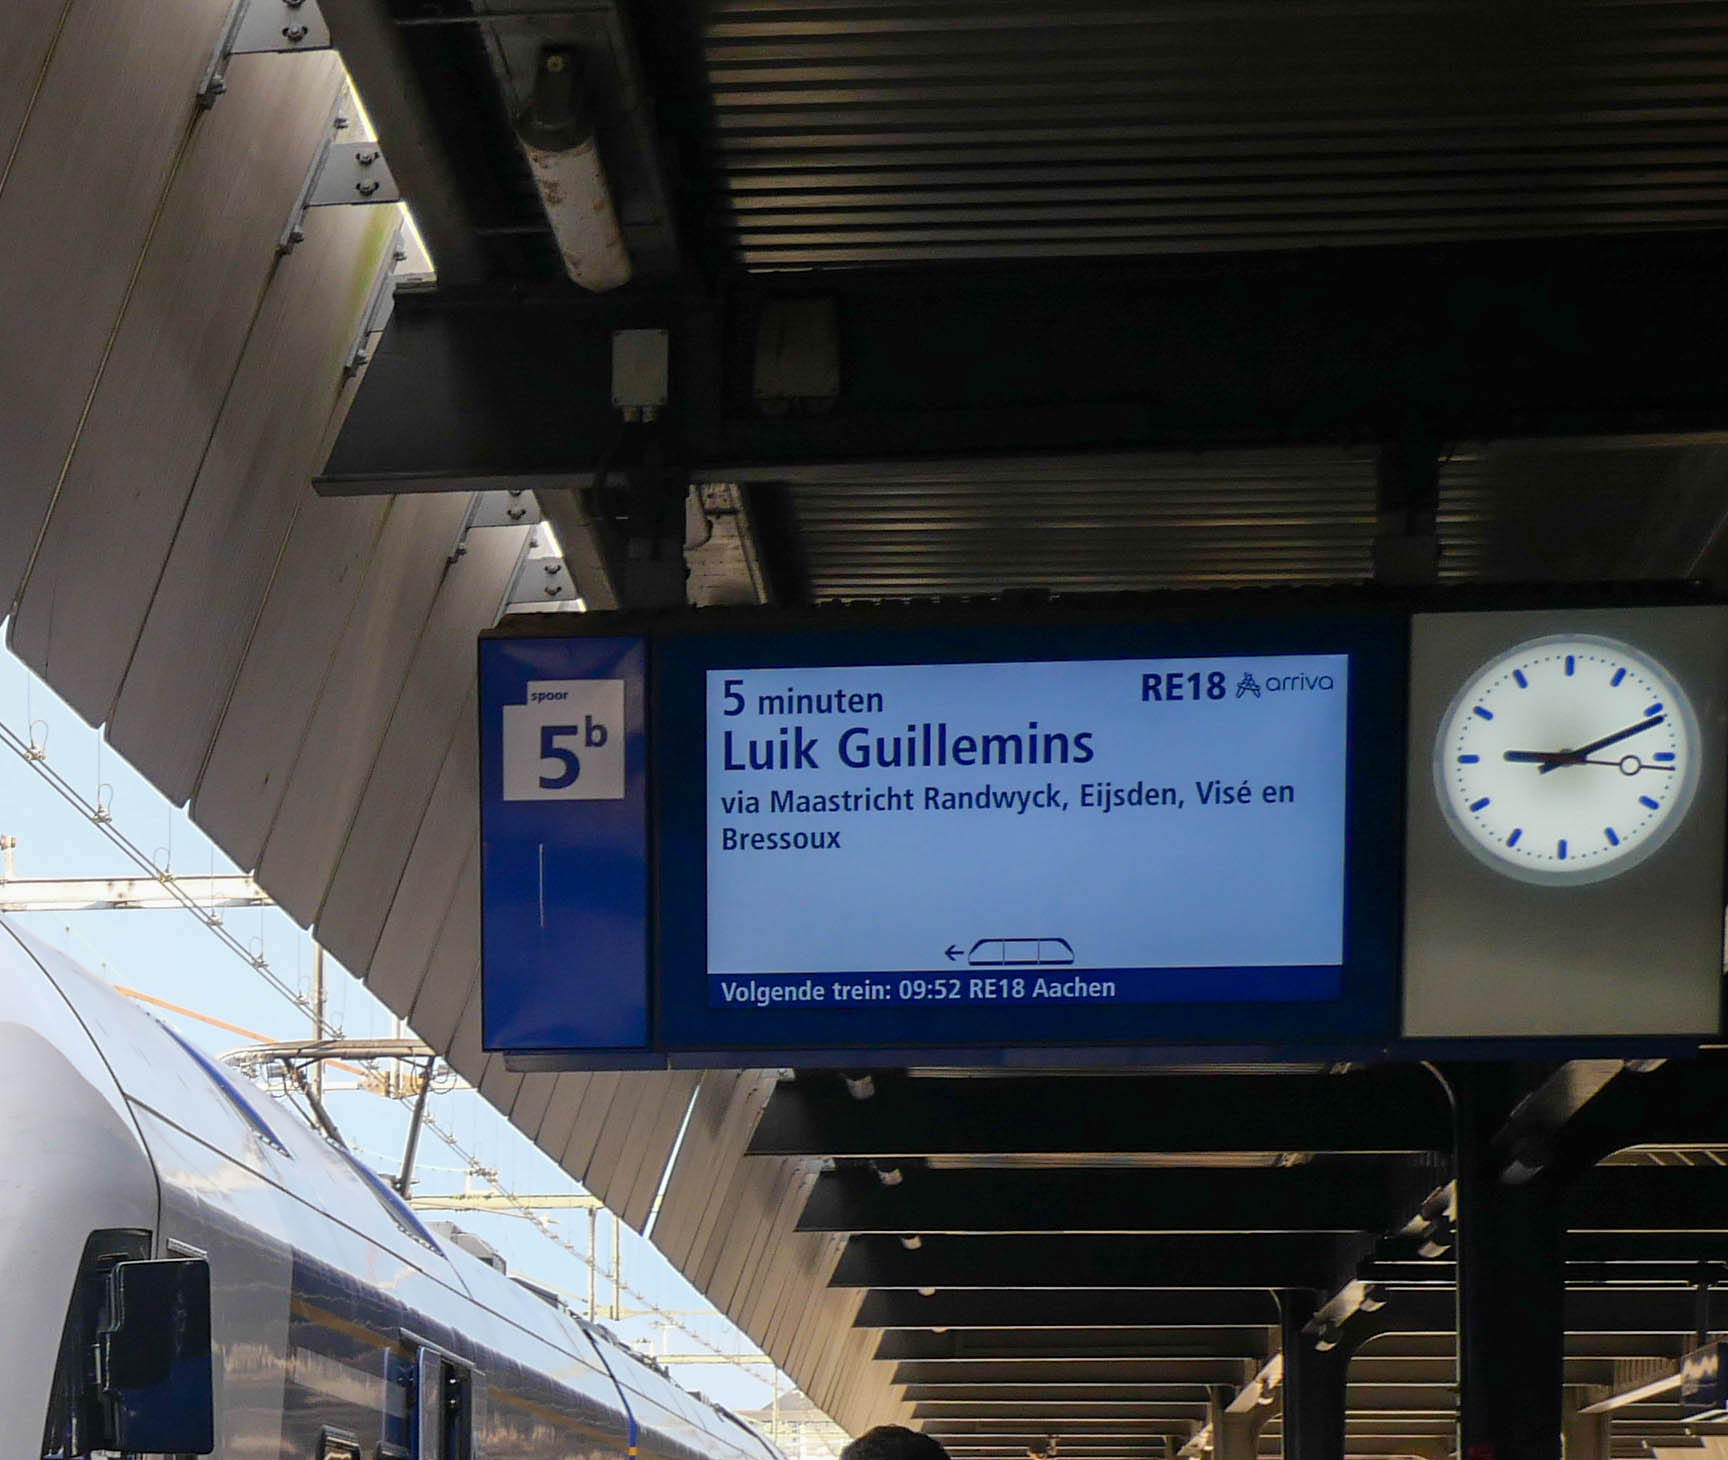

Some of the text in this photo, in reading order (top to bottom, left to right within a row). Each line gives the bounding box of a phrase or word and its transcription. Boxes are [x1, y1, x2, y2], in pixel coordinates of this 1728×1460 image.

[530, 691, 569, 704] spoor
[723, 679, 884, 716] 5 minuten
[1141, 671, 1334, 702] RE18 arriva
[723, 721, 1094, 771] Luik Guillemins
[721, 780, 1295, 815] via Maastricht Randwyck, Eijsden, Visé en
[722, 828, 842, 851] Bressoux
[721, 978, 1116, 1007] Volgende trein: 09:52 RE18 Aachen
